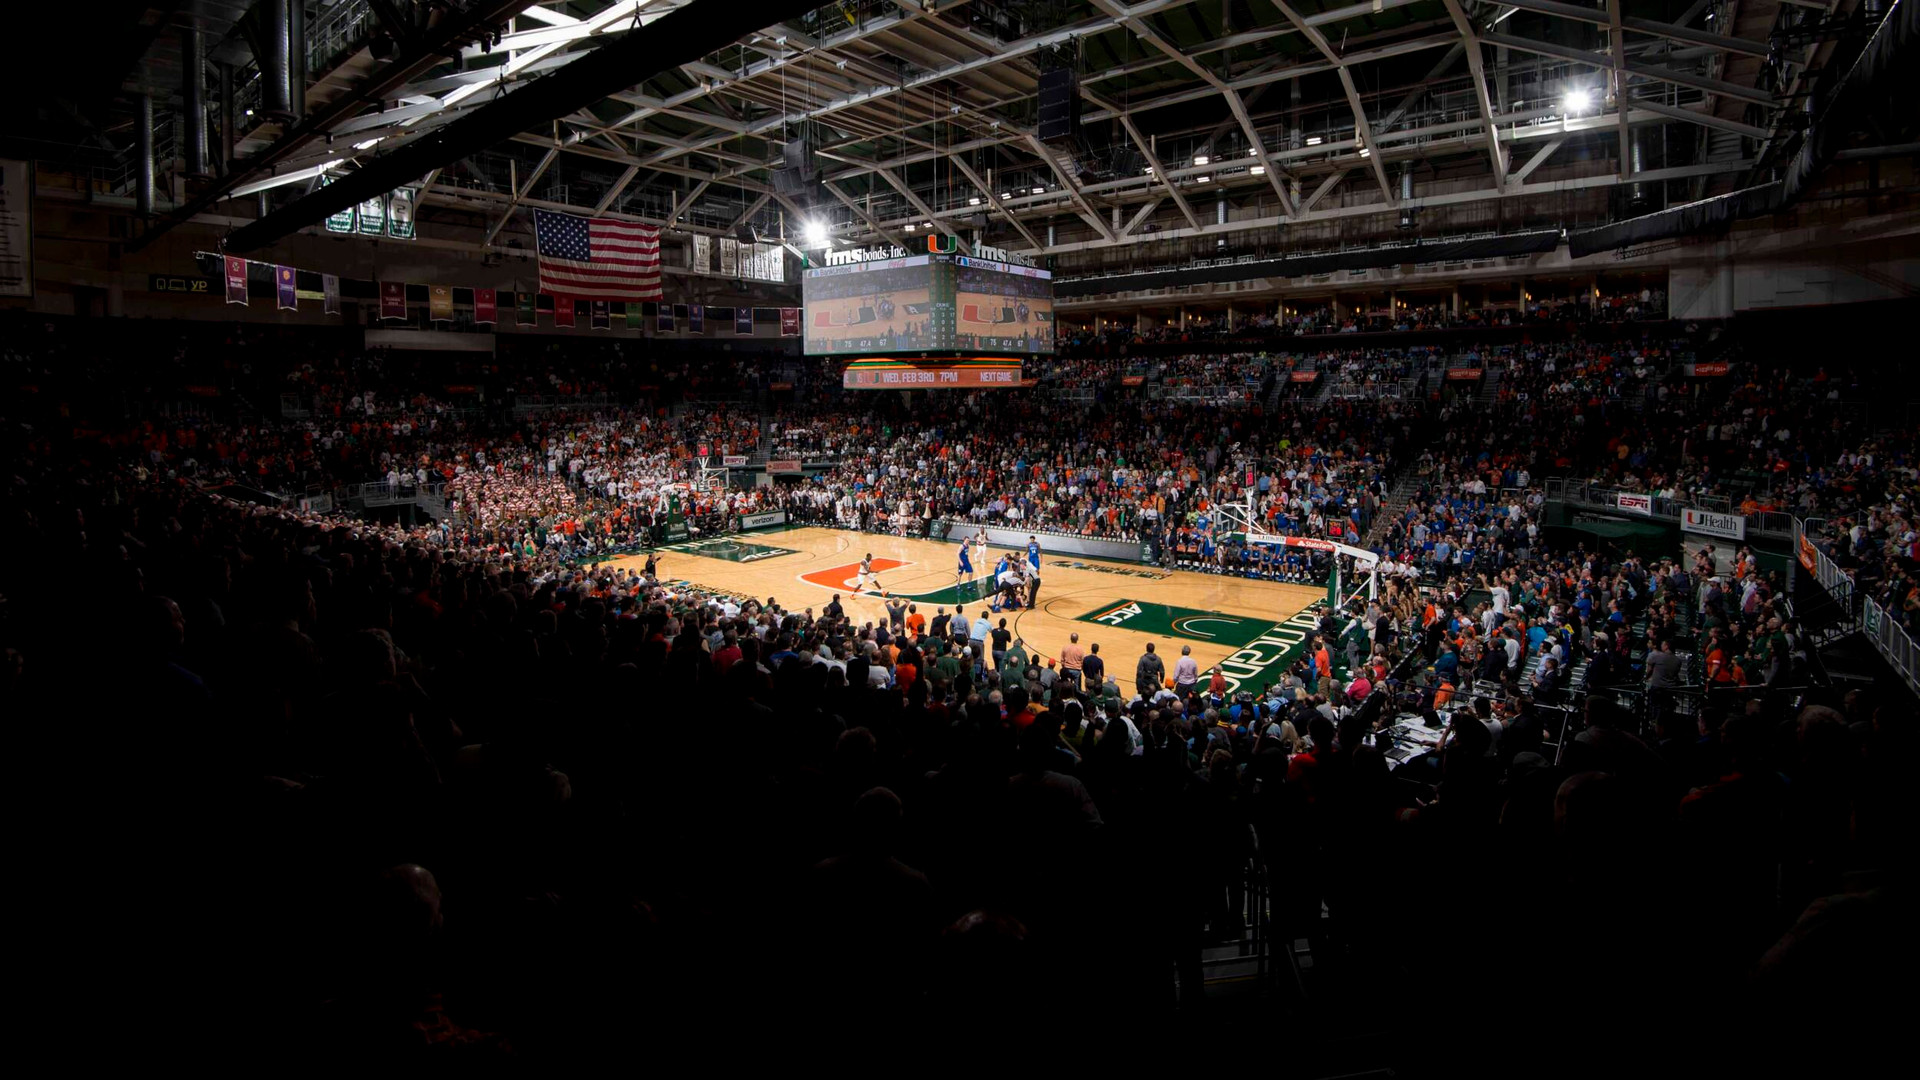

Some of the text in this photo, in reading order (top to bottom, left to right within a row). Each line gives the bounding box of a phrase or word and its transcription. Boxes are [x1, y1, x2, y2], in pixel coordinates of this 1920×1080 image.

[890, 245, 906, 258] Inc.
[968, 258, 997, 271] BankUnited
[902, 372, 916, 382] FEB
[918, 372, 935, 382] 3RD
[939, 371, 958, 382] 7PM
[980, 372, 1012, 382] NEXT GAME
[1620, 496, 1648, 508] ESPN
[751, 516, 774, 525] verizon
[1097, 603, 1142, 625] ACC
